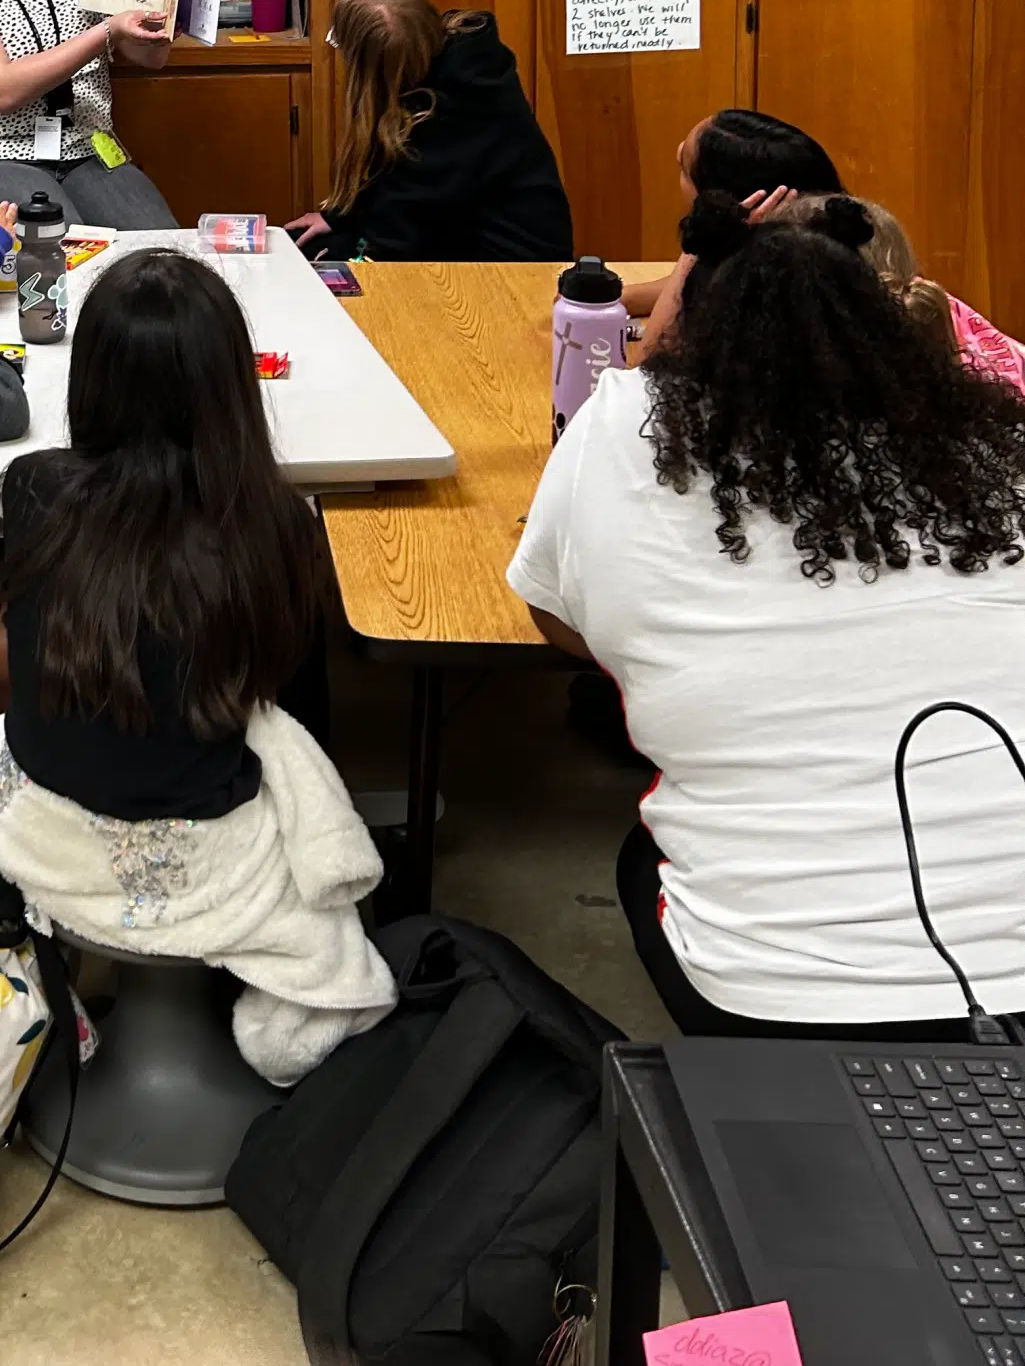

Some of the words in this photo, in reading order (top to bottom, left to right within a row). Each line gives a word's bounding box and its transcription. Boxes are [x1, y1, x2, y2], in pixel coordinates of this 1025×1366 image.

[572, 7, 582, 21] 2
[638, 3, 655, 14] We
[661, 3, 686, 13] will
[572, 22, 586, 31] no
[594, 19, 631, 35] longer
[639, 16, 656, 26] use
[662, 15, 692, 25] them
[587, 30, 613, 46] they
[622, 27, 648, 38] can't
[655, 27, 668, 36] be
